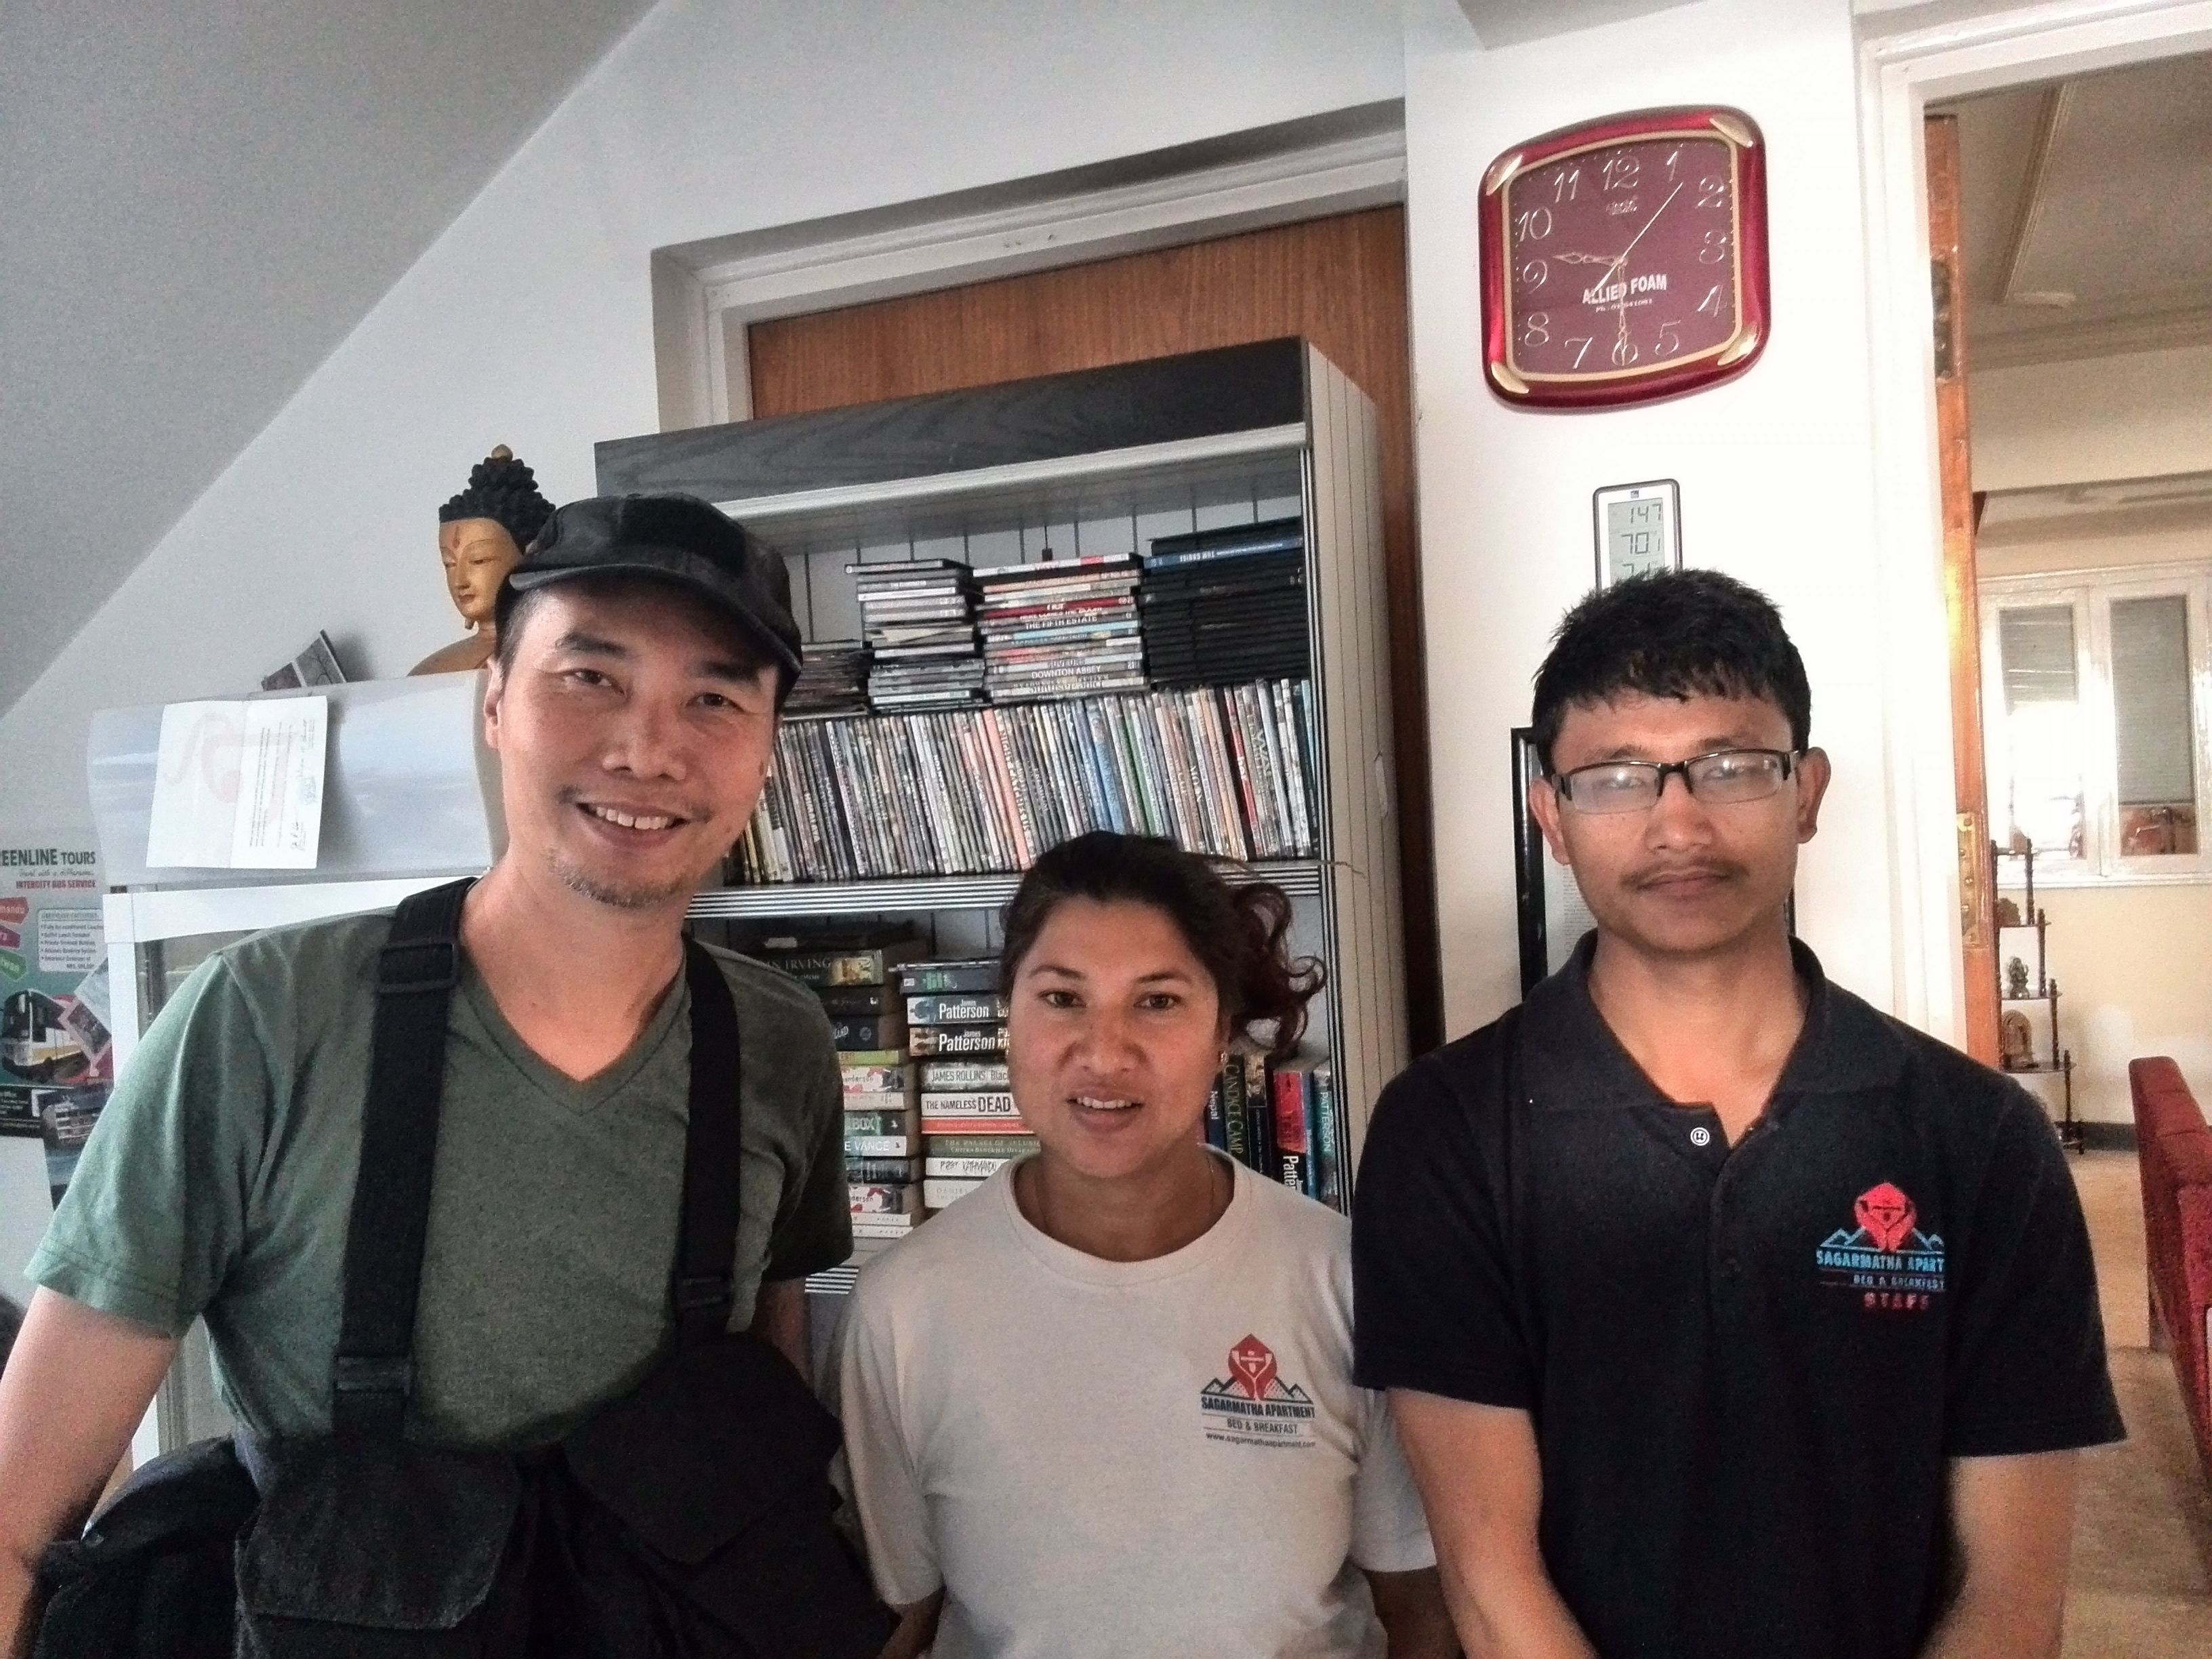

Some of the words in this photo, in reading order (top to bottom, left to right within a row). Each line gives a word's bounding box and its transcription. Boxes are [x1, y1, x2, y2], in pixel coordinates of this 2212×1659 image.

[1603, 155, 1640, 190] 12
[1666, 150, 1678, 182] 1
[1553, 169, 1581, 203] 11
[1695, 174, 1725, 209] 2
[1518, 206, 1552, 242] 10
[1699, 230, 1727, 265] 3
[1523, 259, 1549, 294] 9
[1582, 283, 1627, 304] ALLIED
[1630, 274, 1667, 295] FOAM
[1698, 285, 1723, 318] 4
[1524, 311, 1550, 347] 8
[1655, 319, 1682, 356] 5
[1564, 337, 1593, 369] 7
[1611, 334, 1639, 365] 6
[1025, 621, 1040, 630] THE
[1042, 619, 1065, 628] FIFTH
[1066, 616, 1098, 626] ESTATE
[1031, 668, 1075, 679] DOWNTON
[1076, 665, 1102, 676] ABBEY
[933, 754, 944, 787] CANYON
[1236, 756, 1248, 781] her
[804, 792, 821, 842] HIMALAYA
[0, 848, 58, 866] EENLINE
[60, 851, 96, 865] TOURS
[68, 880, 96, 888] SERVICE
[785, 958, 832, 972] IRVING
[939, 1003, 989, 1019] Patterson
[939, 1033, 996, 1051] Patterson
[963, 1029, 981, 1038] James
[931, 1071, 954, 1081] JAMES
[956, 1070, 986, 1081] ROLLINS
[926, 1101, 939, 1110] THE
[940, 1099, 977, 1109] NAMELESS
[978, 1097, 1011, 1112] DEAD
[1208, 1090, 1219, 1120] Nepal
[1223, 1063, 1242, 1119] CANDACE
[1319, 1091, 1333, 1152] PATTERSON
[854, 1141, 890, 1151] VANCE
[1227, 1120, 1244, 1154] CAMP
[1816, 1250, 1902, 1271] SAGARMATHA
[1201, 1396, 1264, 1416] SAGARMATHA
[1265, 1404, 1316, 1419] APARTMENT
[1227, 1418, 1243, 1430] BED
[1245, 1421, 1252, 1431] &
[1254, 1422, 1298, 1435] BREAKFAST
